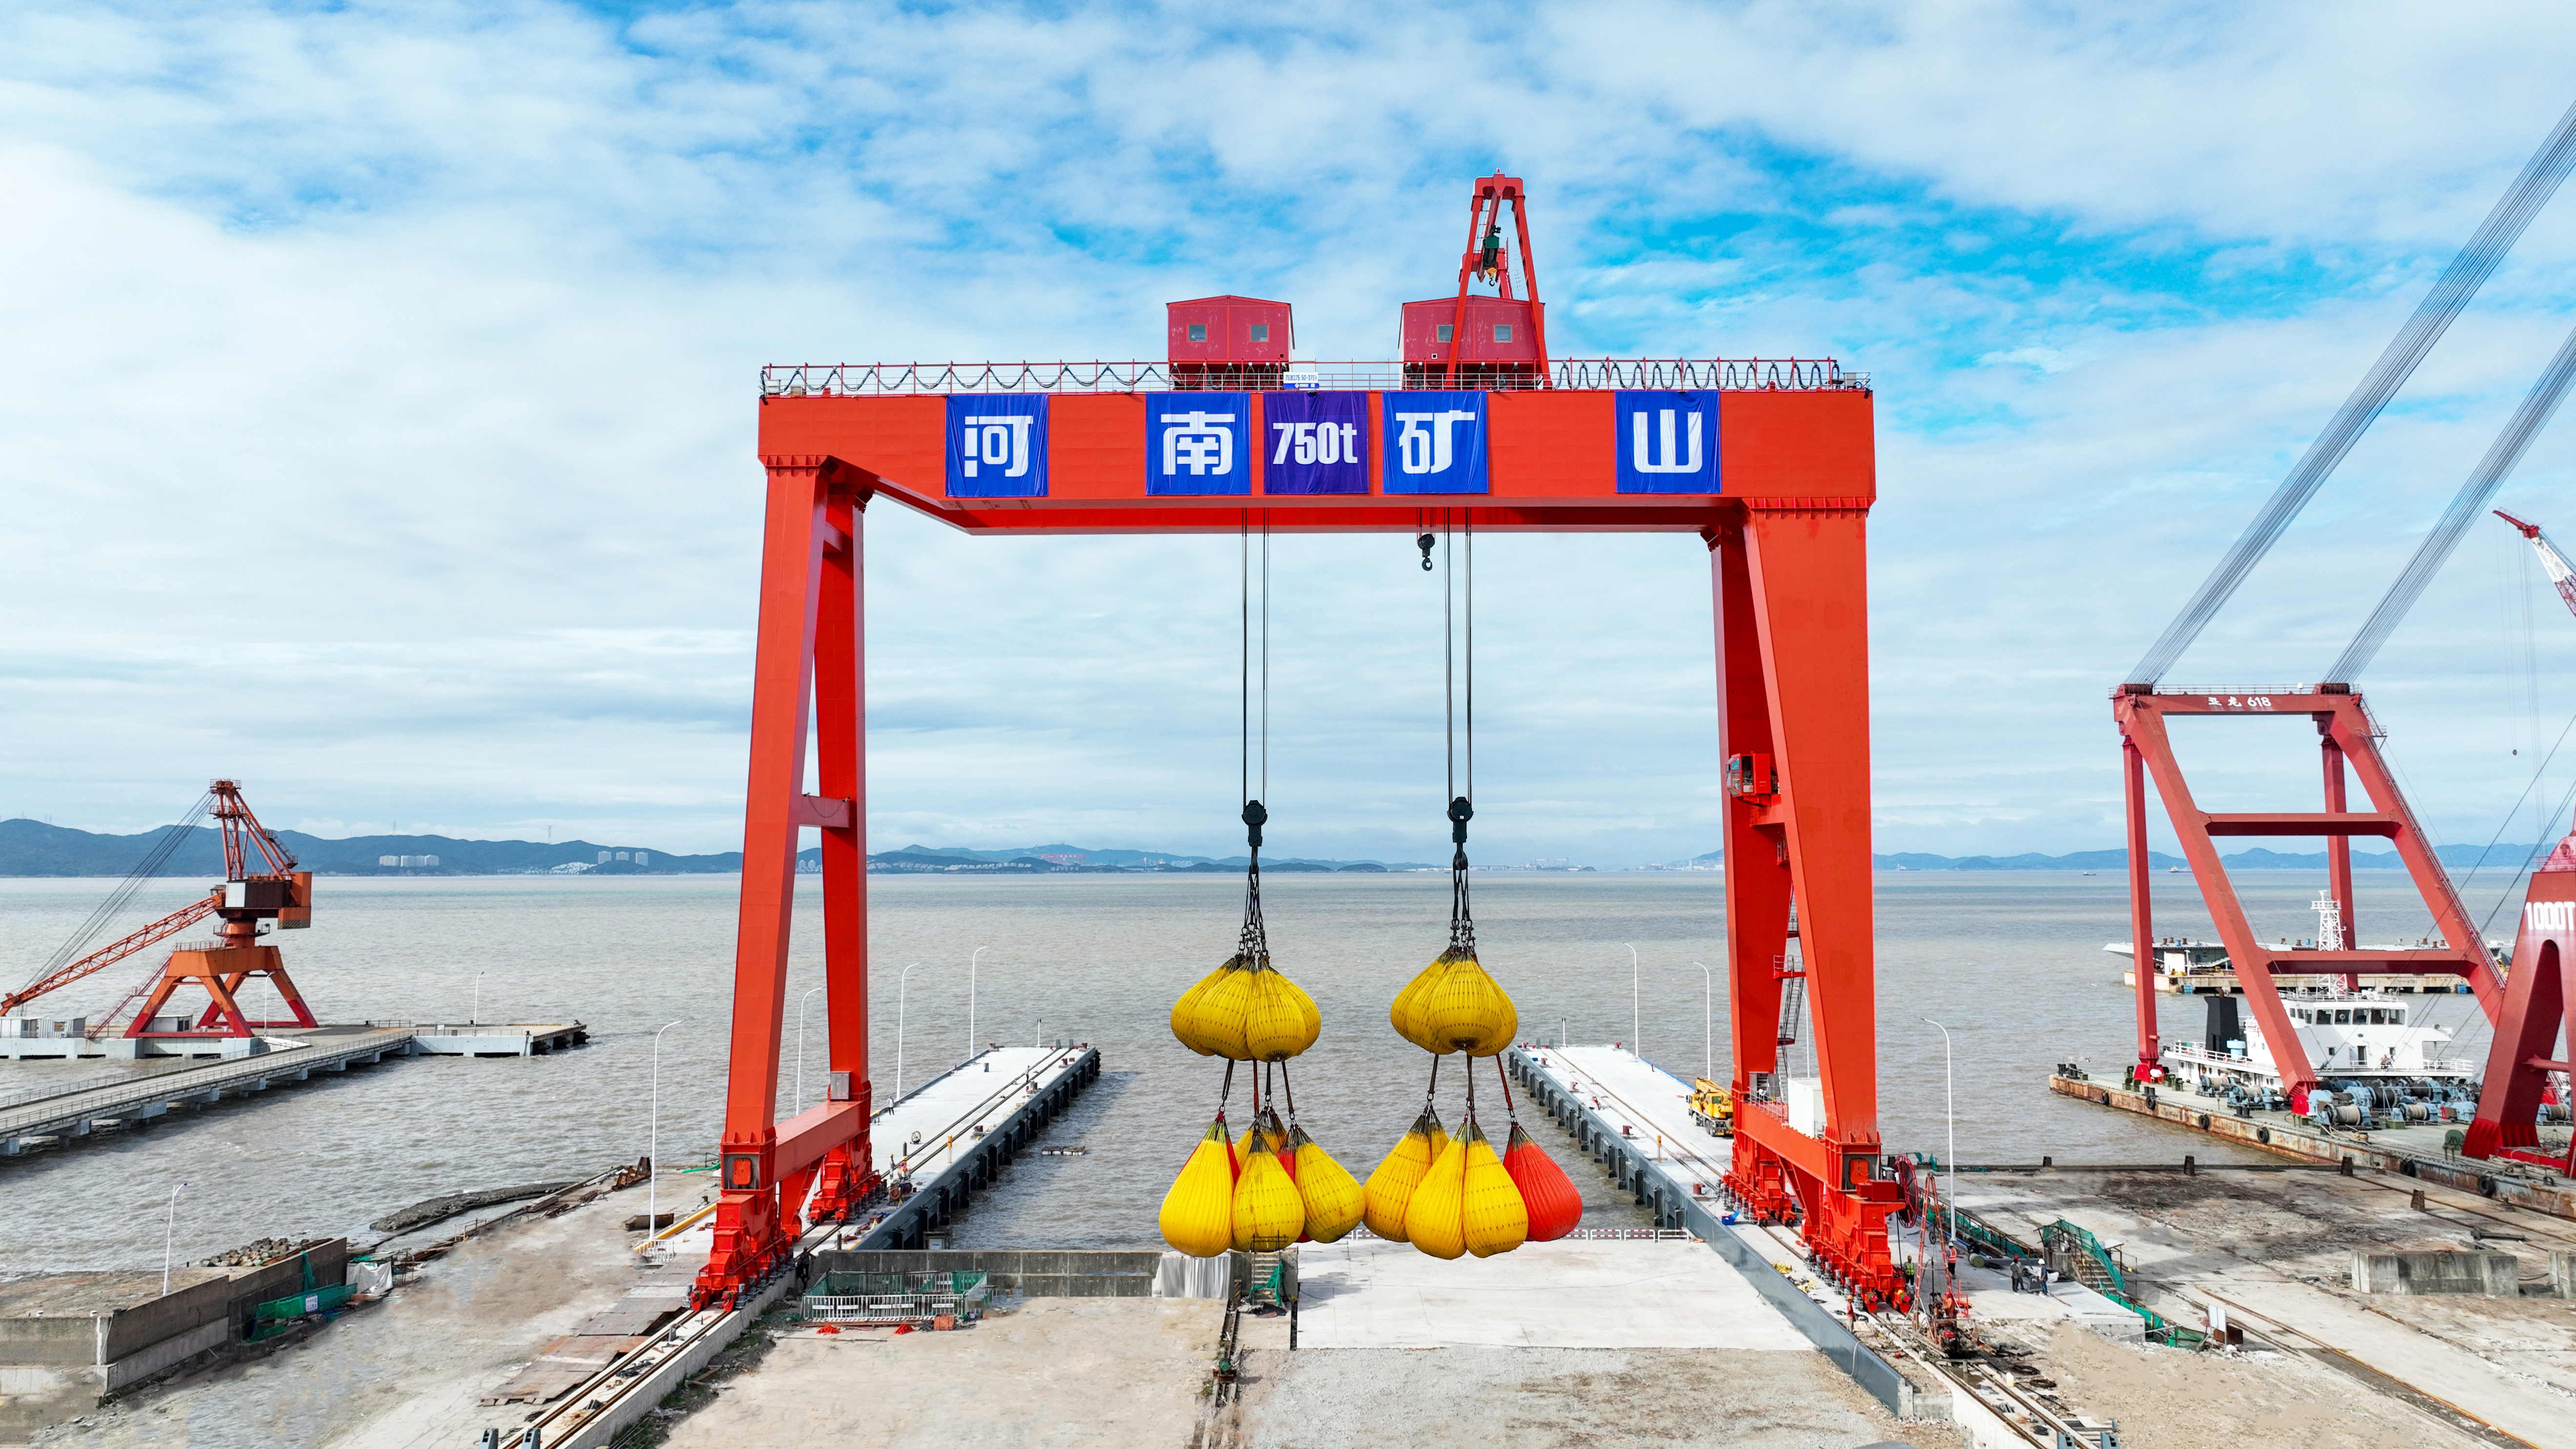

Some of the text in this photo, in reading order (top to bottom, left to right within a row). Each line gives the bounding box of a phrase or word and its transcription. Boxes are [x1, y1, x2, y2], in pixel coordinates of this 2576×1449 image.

[965, 409, 1703, 477] 河 南 750t 矿 山
[2247, 696, 2272, 707] 618
[2524, 901, 2576, 930] 1000T
